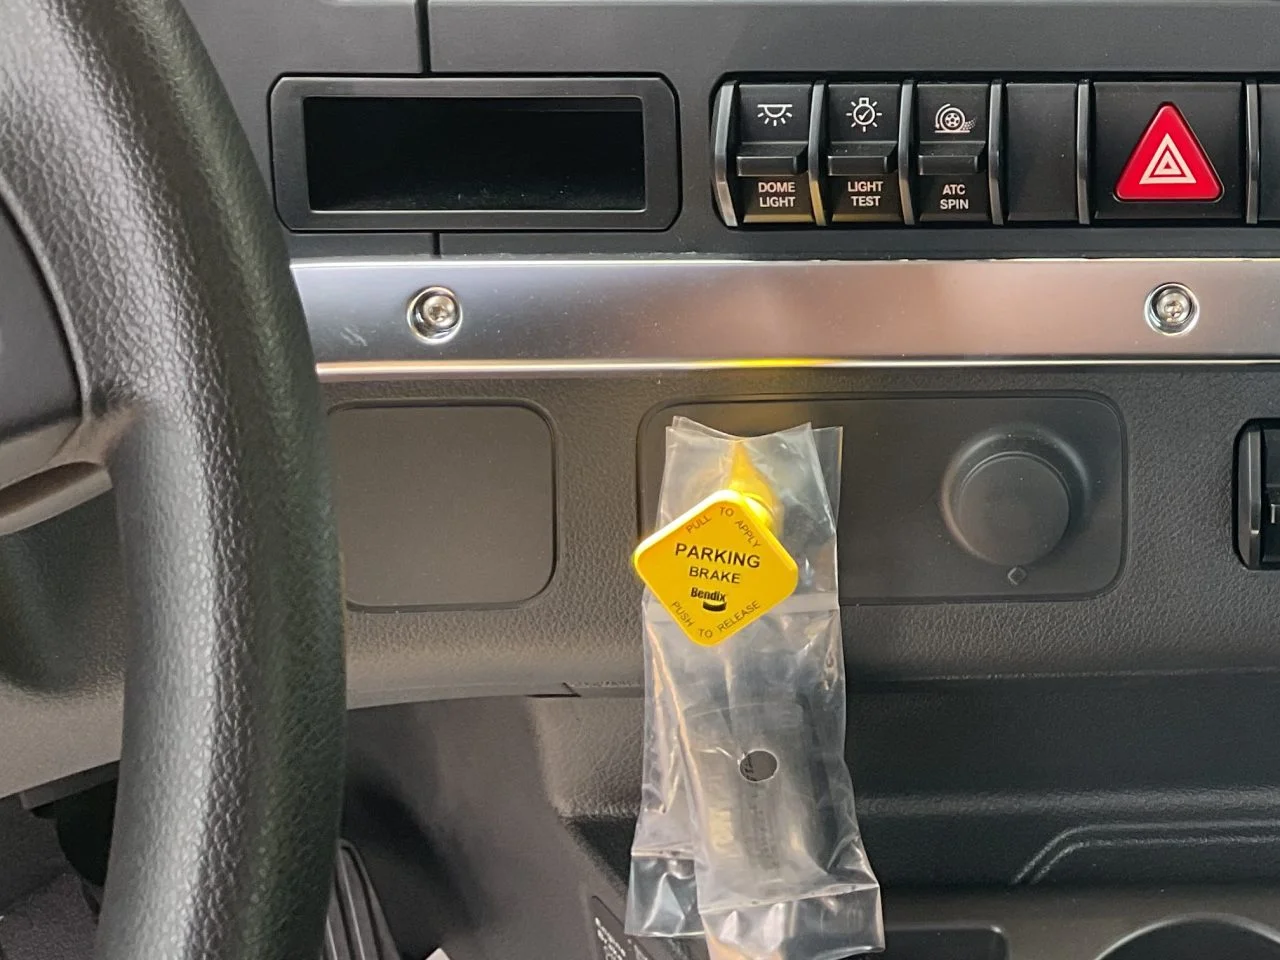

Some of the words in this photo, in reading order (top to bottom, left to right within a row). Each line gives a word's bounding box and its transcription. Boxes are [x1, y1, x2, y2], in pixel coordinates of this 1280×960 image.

[758, 181, 796, 193] DOME
[848, 180, 884, 192] LIGHT
[942, 184, 966, 195] ATC
[759, 196, 796, 208] LIGHT
[851, 195, 881, 207] TEST
[940, 198, 969, 210] SPIN
[685, 514, 712, 534] PULL
[719, 506, 734, 517] TO
[735, 519, 762, 548] APPLY
[675, 541, 761, 569] PARKING
[688, 565, 741, 584] BRAKE
[690, 587, 726, 602] Bendix
[671, 600, 696, 627] PUSH
[697, 628, 713, 639] TO
[717, 600, 761, 633] RELEASE
